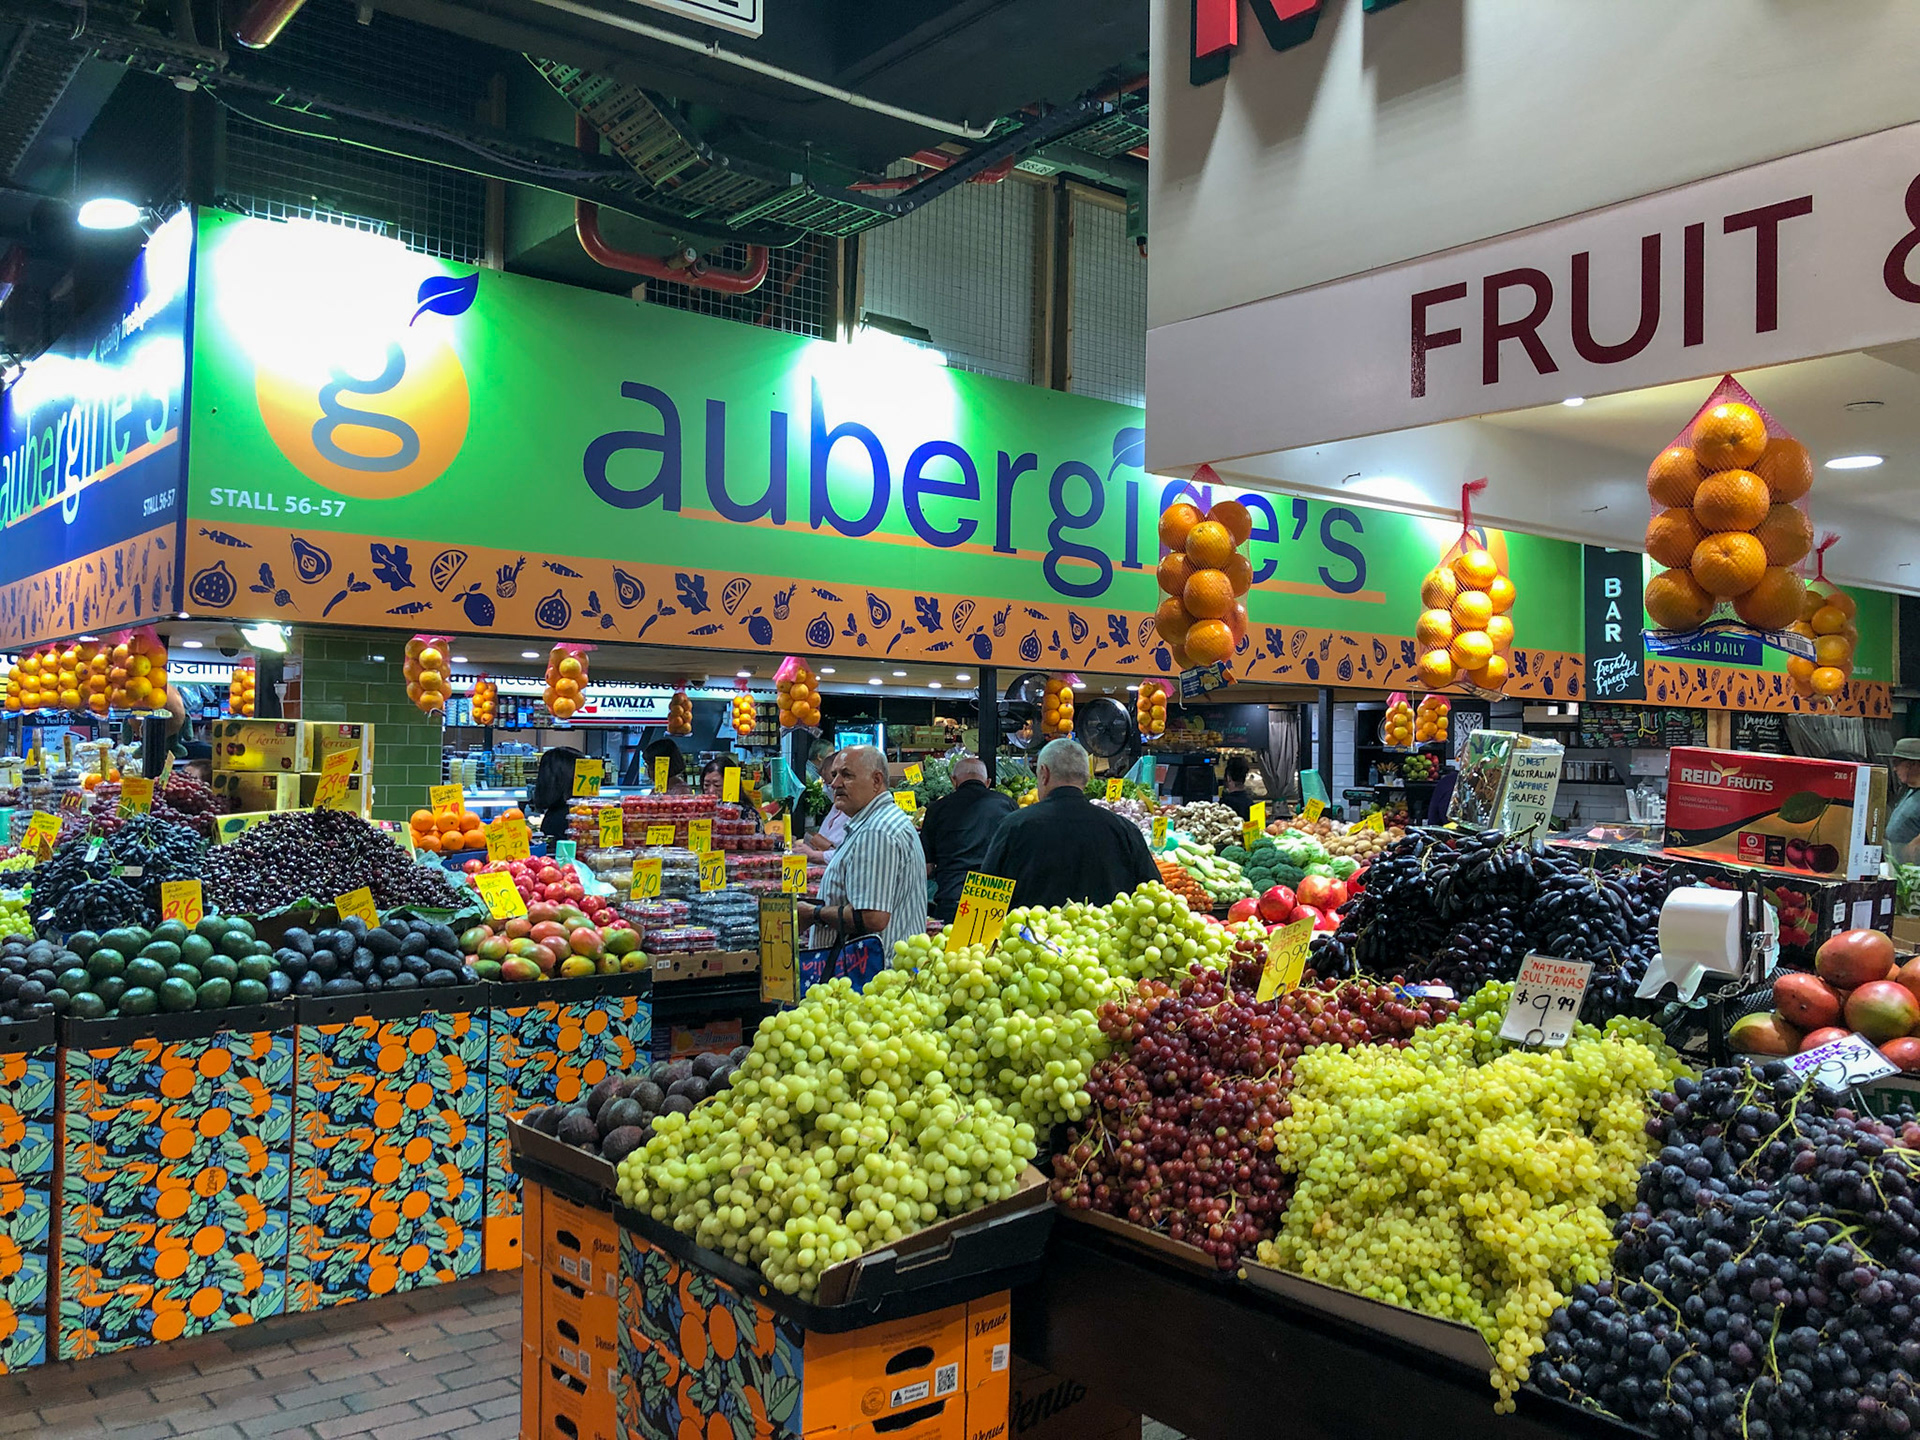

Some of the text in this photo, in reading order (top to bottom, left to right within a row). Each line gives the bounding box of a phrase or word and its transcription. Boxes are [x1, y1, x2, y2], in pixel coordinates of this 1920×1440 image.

[1411, 195, 1813, 399] FRUIT
[209, 487, 347, 519] STALL 56-57
[1604, 577, 1623, 643] BAR
[1714, 641, 1746, 657] DAILY
[601, 696, 656, 709] LAVAZZA
[1517, 754, 1547, 767] SWEET
[1511, 767, 1558, 779] AUSTRALIAN
[1681, 768, 1774, 792] REID FRUITS
[1507, 791, 1546, 806] GRAPES
[965, 872, 1014, 893] MENINDEE
[963, 884, 1011, 905] SEEDLESS
[184, 897, 202, 924] 6
[1271, 930, 1309, 952] GRAPES
[1281, 923, 1302, 939] RED
[1521, 970, 1585, 990] SULTANAS
[1793, 1044, 1862, 1071] GRAPES
[1794, 1041, 1847, 1063] BLACK
[974, 1310, 1009, 1337] Venus
